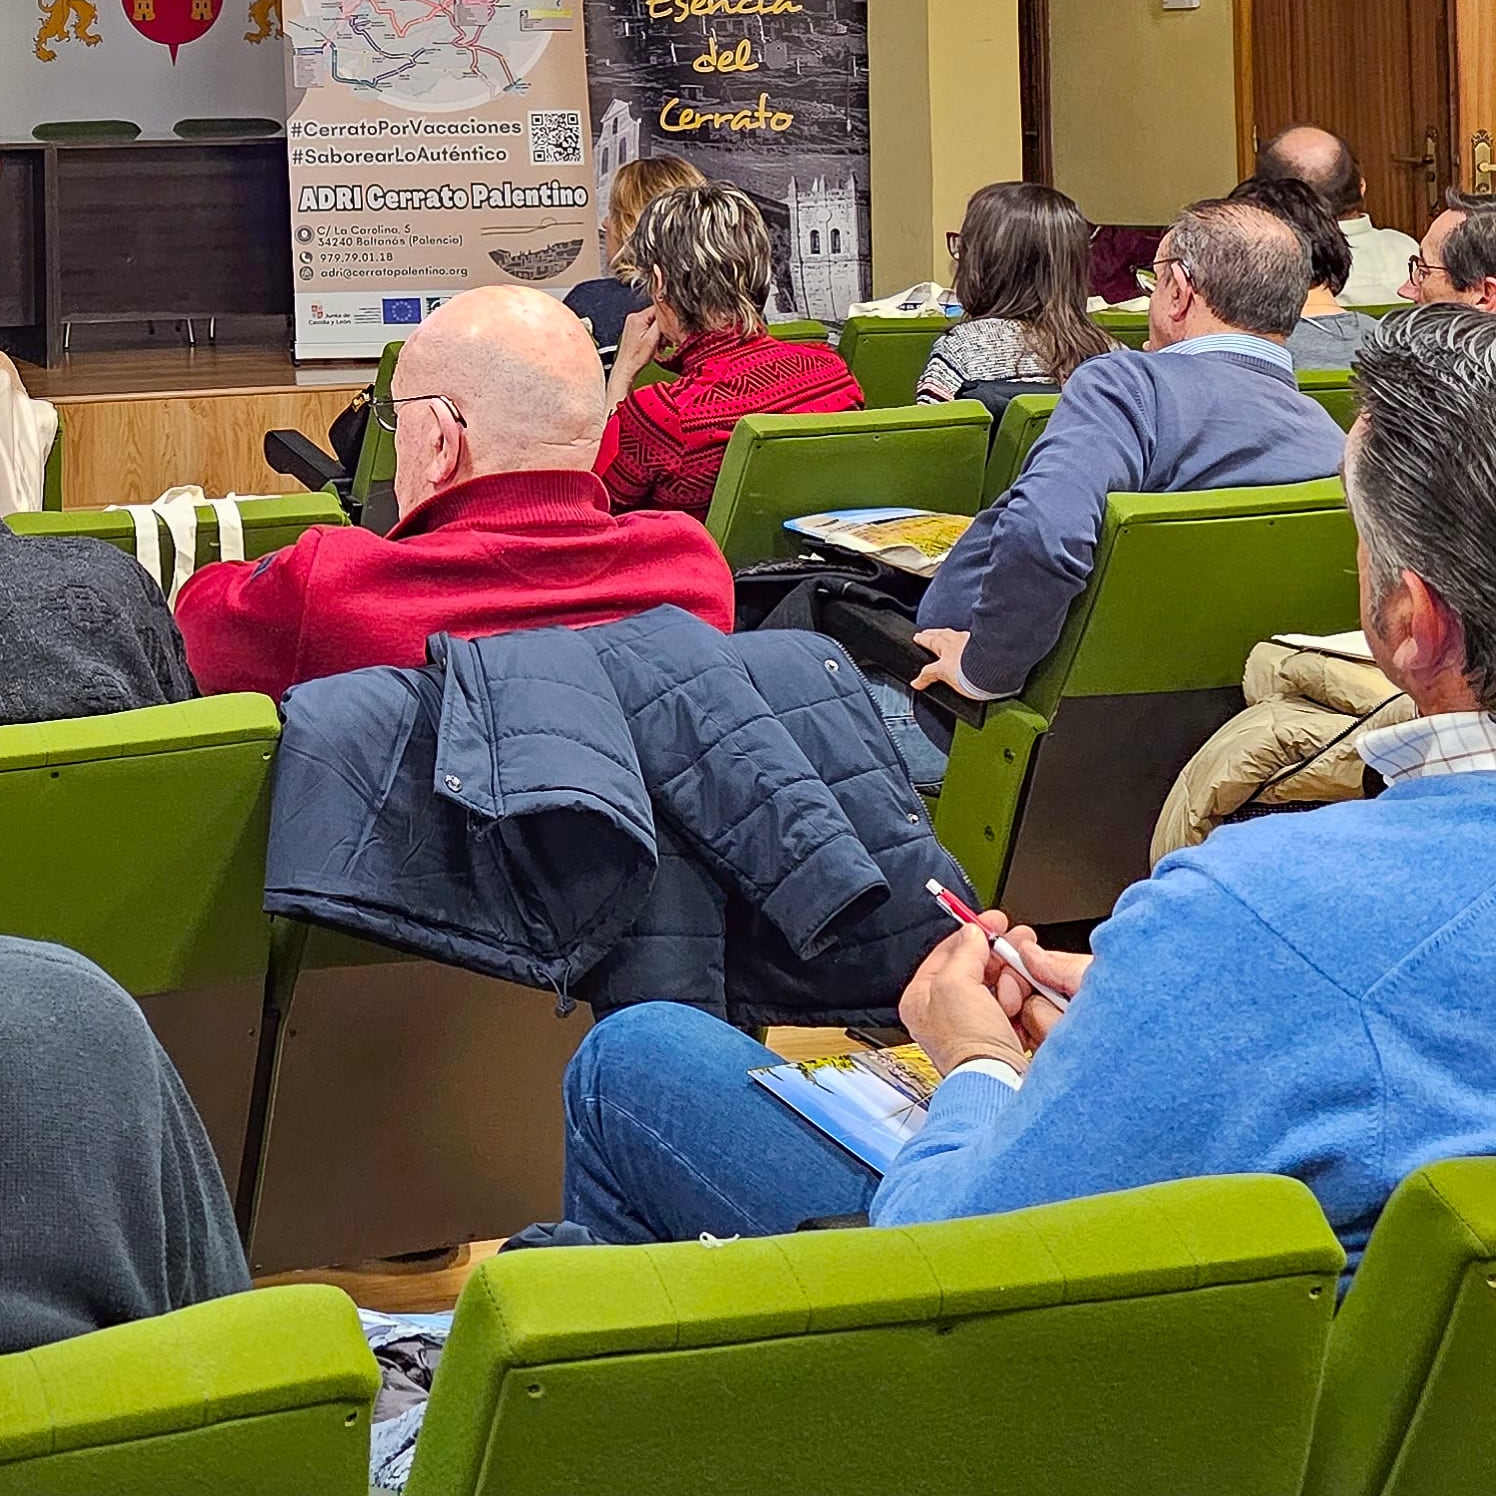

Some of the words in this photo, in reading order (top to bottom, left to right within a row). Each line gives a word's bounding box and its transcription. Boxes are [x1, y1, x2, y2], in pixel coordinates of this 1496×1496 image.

[692, 36, 759, 73] del
[660, 93, 794, 132] Cerrato
[290, 120, 522, 138] #CerratoPorVacaciones
[292, 145, 507, 165] #SaborearLoAuténtico
[298, 185, 363, 212] ADRI
[366, 182, 468, 210] Cerrato
[471, 178, 588, 209] Palentino
[316, 226, 331, 238] C/
[334, 226, 348, 235] La
[317, 237, 353, 247] 34240
[356, 235, 406, 246] Baltanás
[409, 235, 463, 247] (Palencia)
[320, 252, 393, 263] 979.79.01.18
[321, 266, 468, 279] adri@cerratopalentino.org
